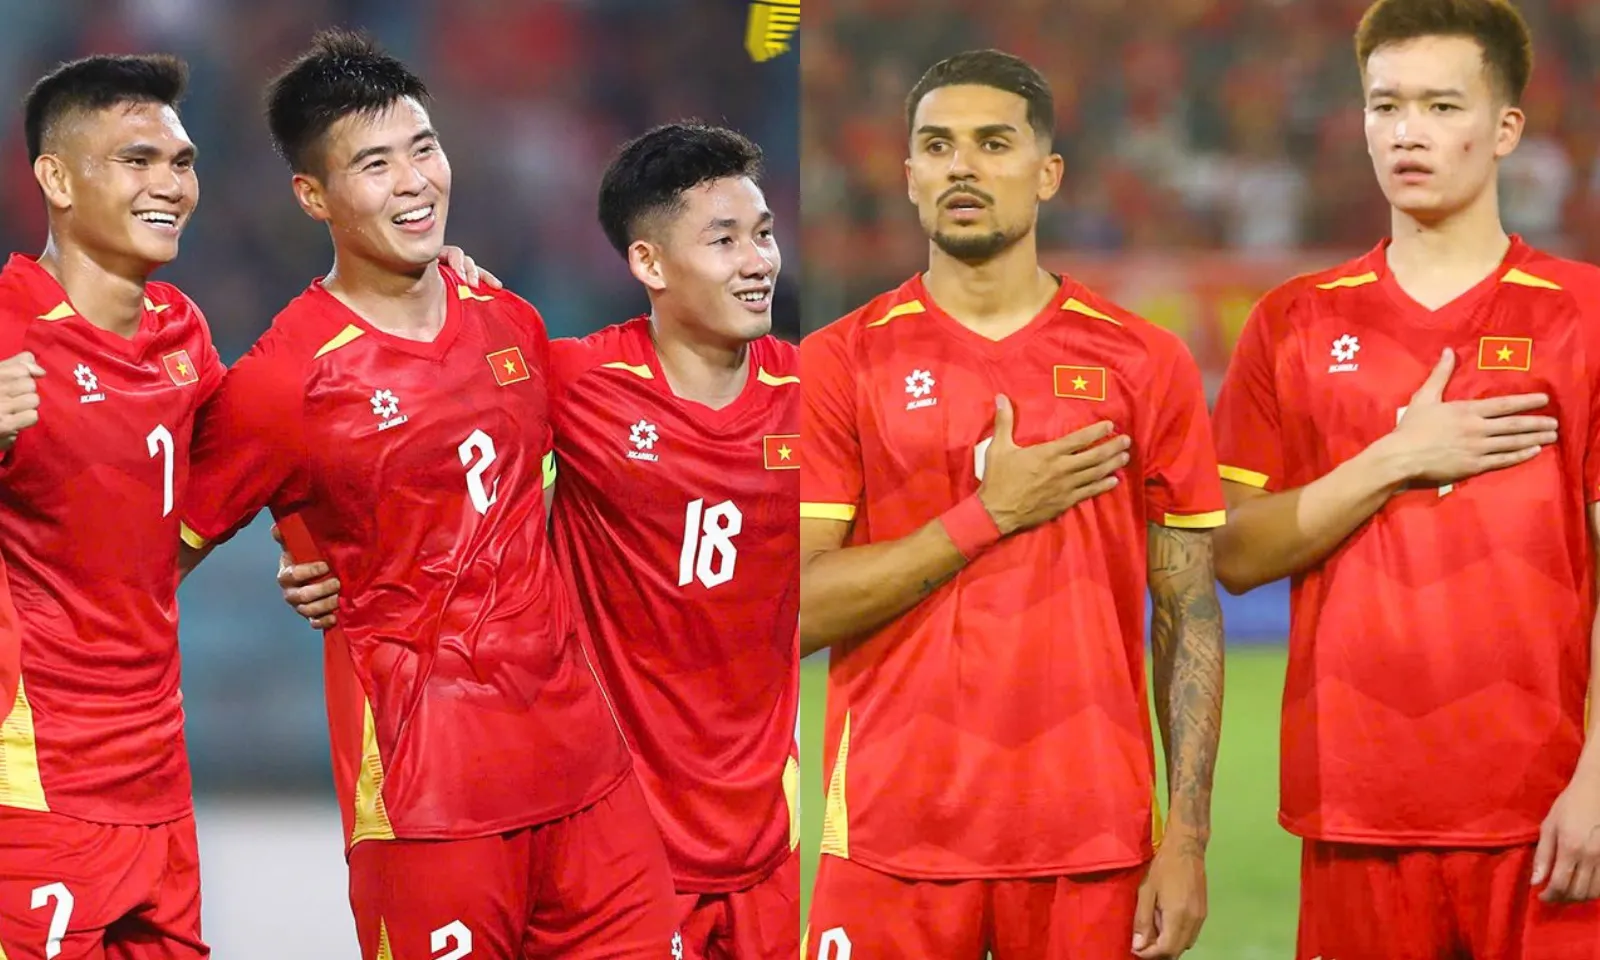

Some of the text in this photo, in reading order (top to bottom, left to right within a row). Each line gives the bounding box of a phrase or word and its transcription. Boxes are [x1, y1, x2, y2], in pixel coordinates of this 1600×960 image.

[457, 429, 500, 514] 2
[679, 498, 742, 589] 18
[30, 881, 74, 960] 7
